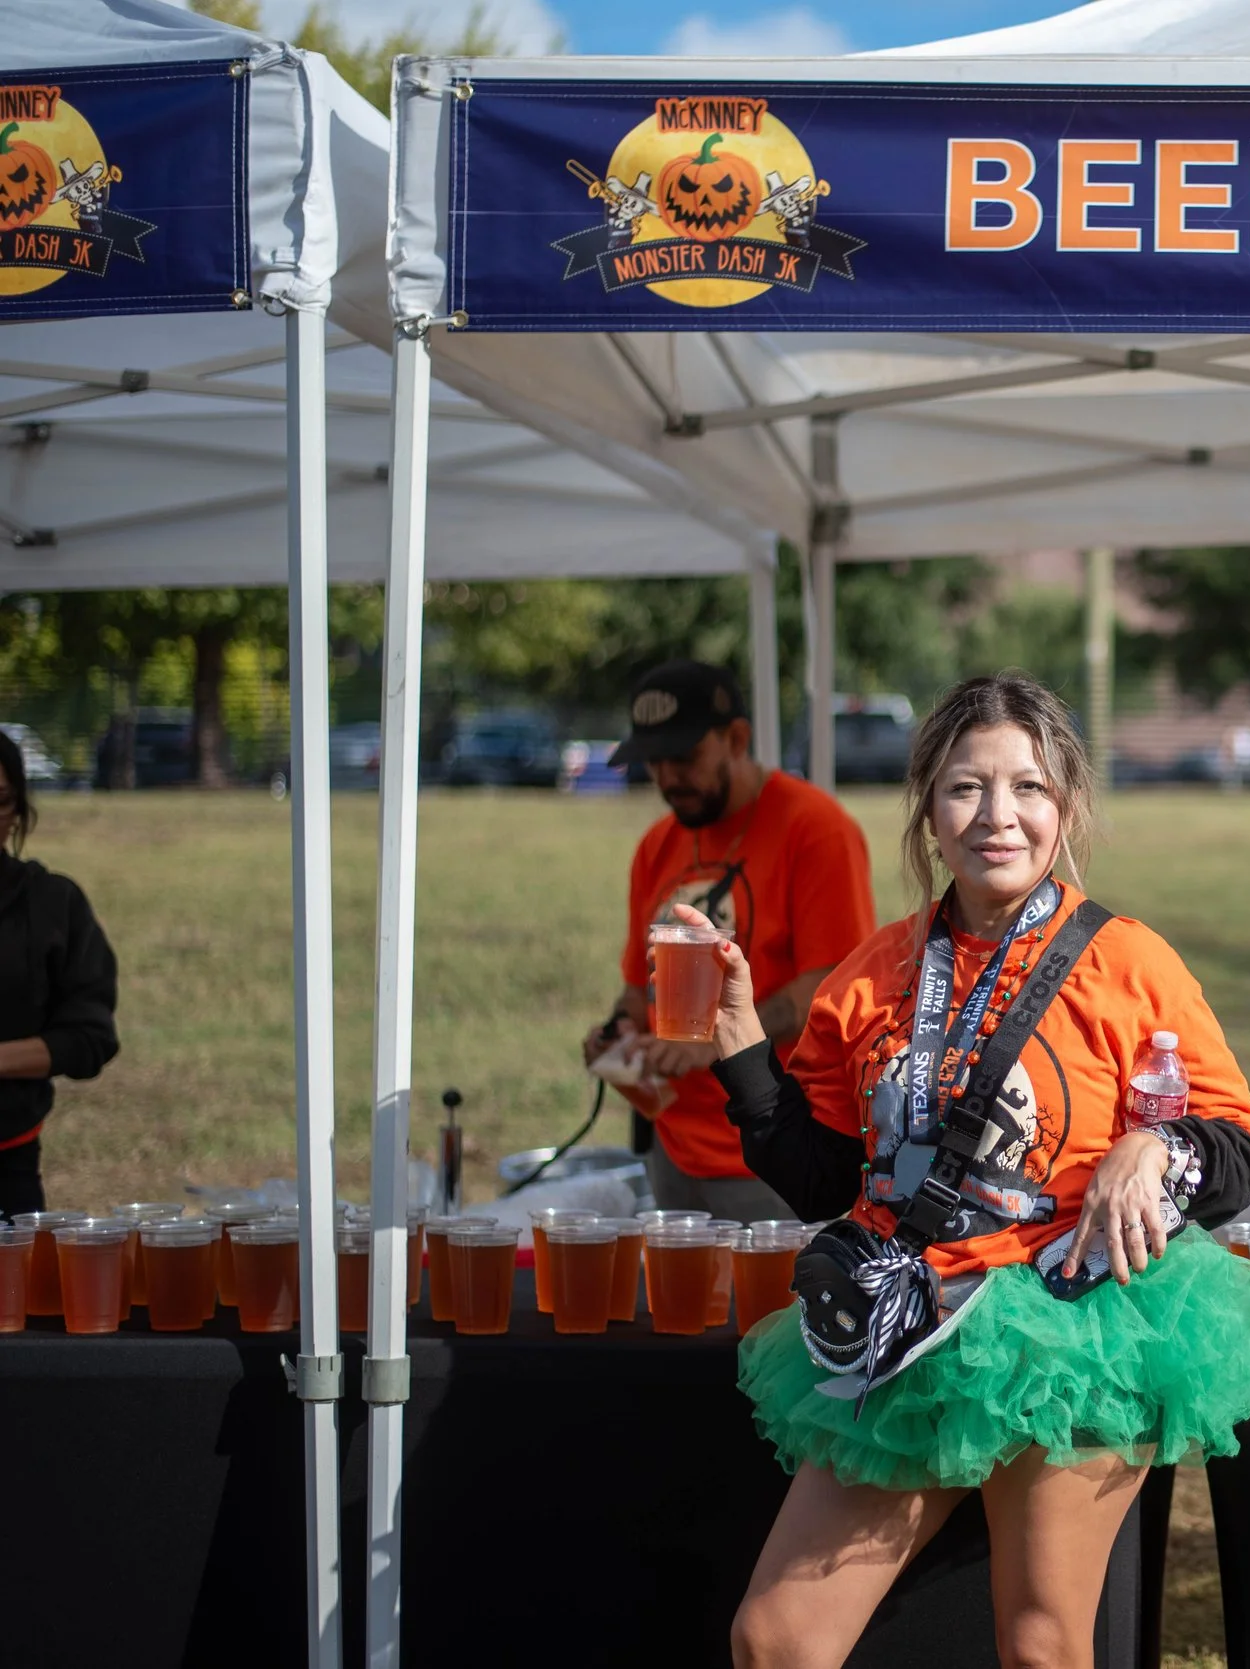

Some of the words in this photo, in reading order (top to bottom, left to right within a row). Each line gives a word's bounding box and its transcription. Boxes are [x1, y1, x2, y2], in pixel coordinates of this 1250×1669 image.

[0, 90, 58, 120] INNEY
[15, 233, 60, 262] DASH
[69, 238, 93, 268] 5K
[614, 244, 705, 283] MONSTER
[718, 244, 766, 274] DASH
[775, 252, 800, 283] 5K
[921, 965, 938, 1012] TRINITY
[932, 979, 947, 1013] FALLS
[962, 986, 981, 1020] FALLS
[1012, 952, 1070, 1028] crocs
[967, 985, 992, 1032] TRINITY
[938, 1047, 964, 1082] 2025
[913, 1051, 931, 1126] TEXANS
[1007, 1194, 1022, 1213] 5K
